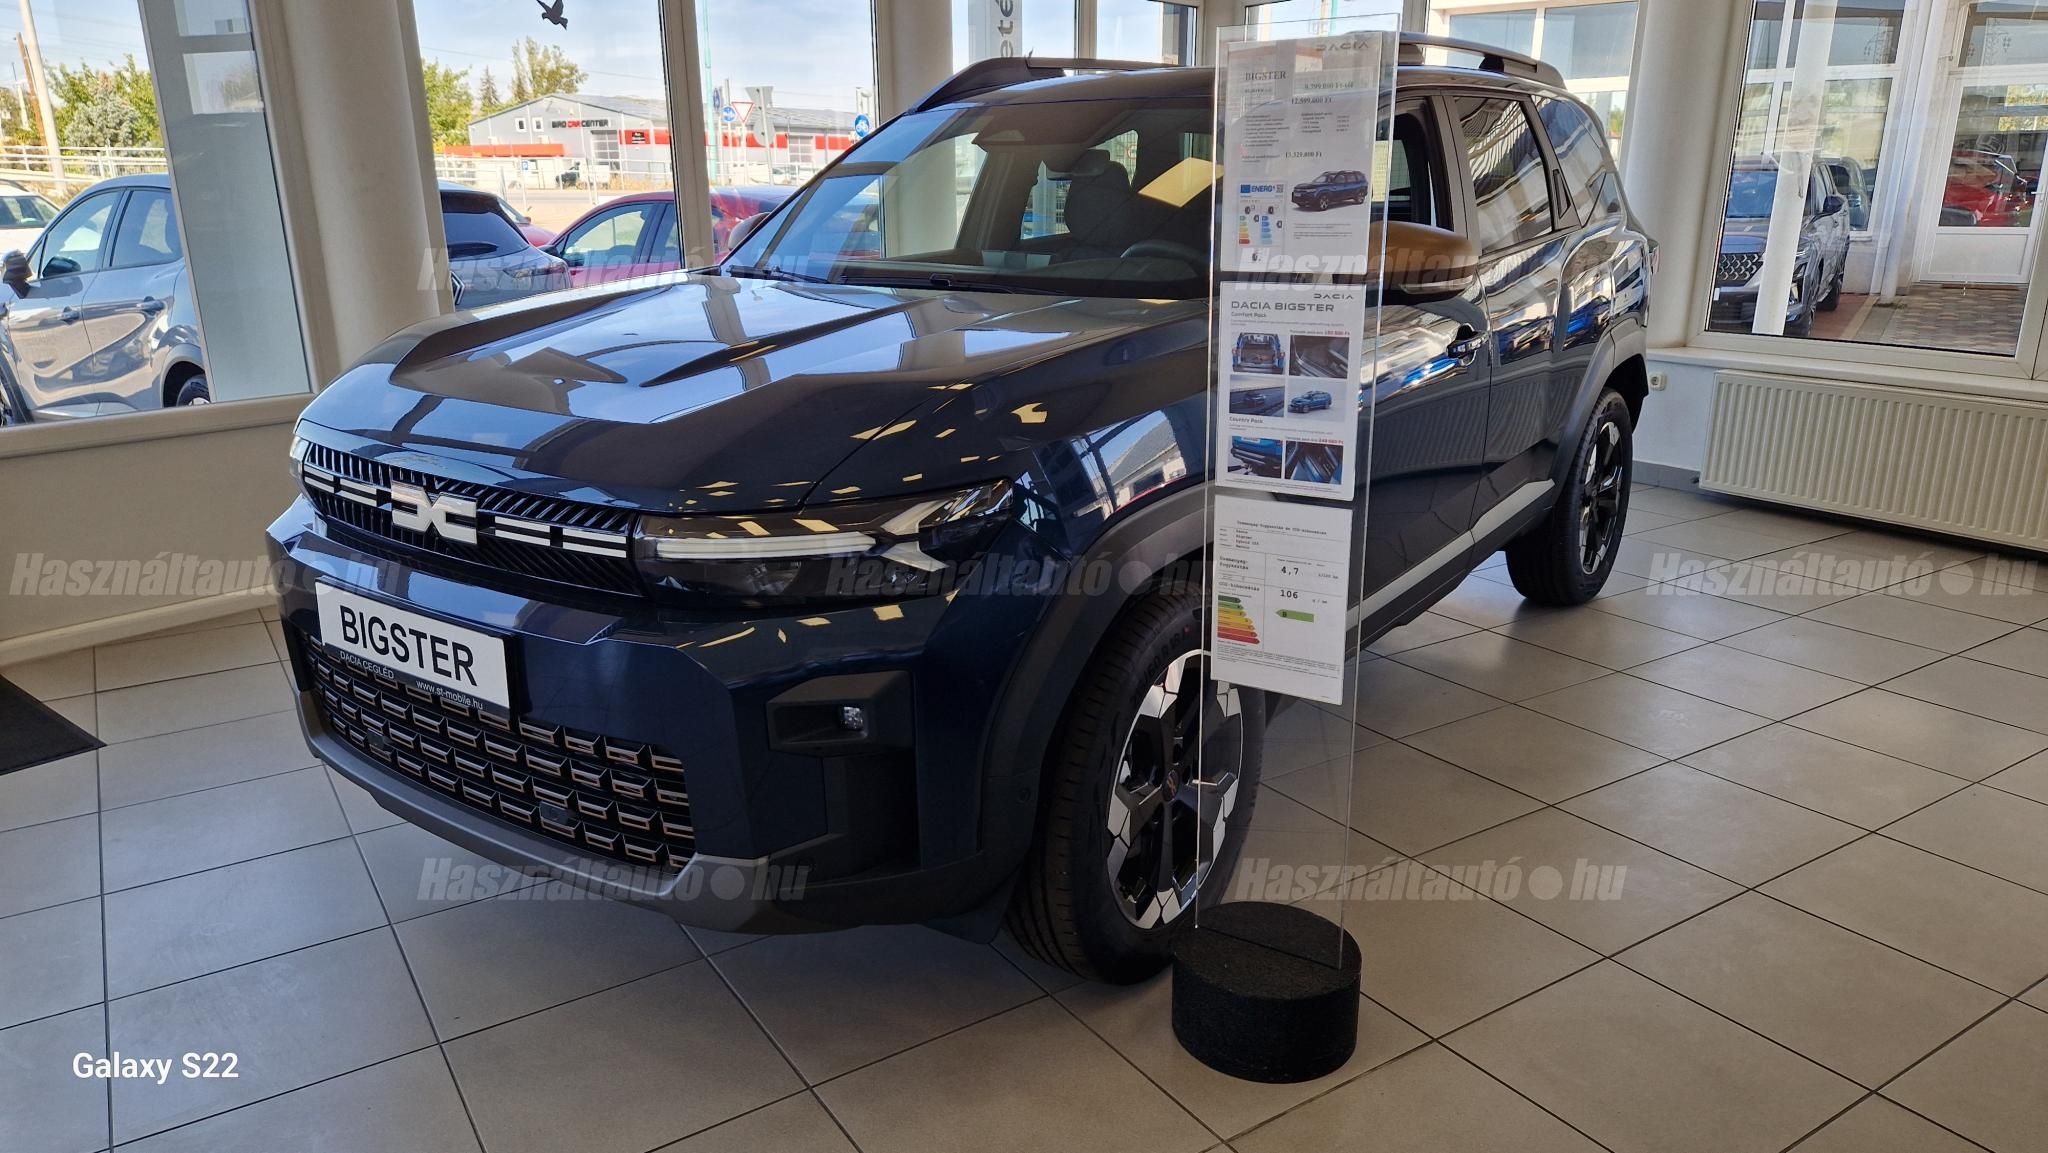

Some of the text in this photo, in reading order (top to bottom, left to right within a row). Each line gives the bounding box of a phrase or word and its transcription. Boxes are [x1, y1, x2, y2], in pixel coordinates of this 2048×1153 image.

[1316, 42, 1369, 52] DACIA
[1246, 71, 1286, 80] BIGSTER
[1231, 301, 1335, 312] DACIA BIGSTER
[1281, 566, 1299, 576] 4,7
[1280, 589, 1298, 599] 106
[340, 605, 478, 686] BIGSTER
[340, 650, 394, 680] DACIA CEGLÉD
[416, 680, 483, 710] www.st-mobile.hu
